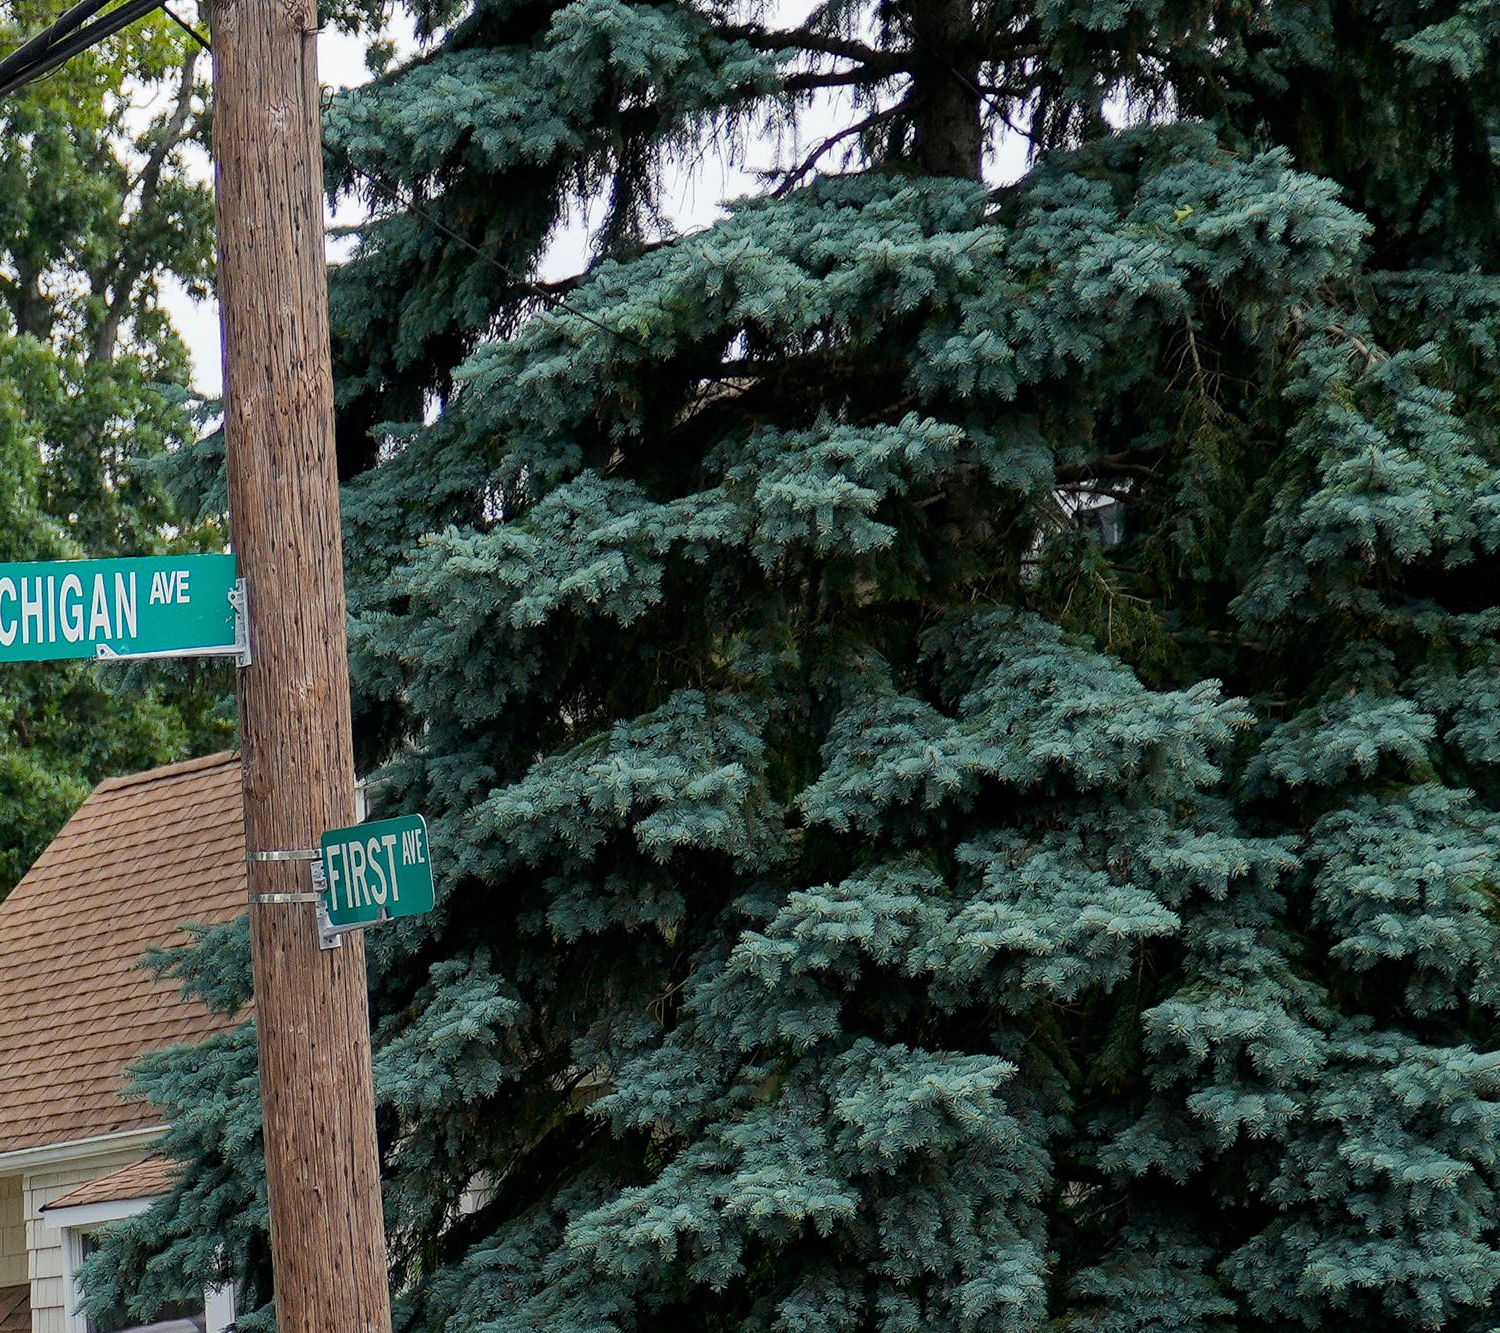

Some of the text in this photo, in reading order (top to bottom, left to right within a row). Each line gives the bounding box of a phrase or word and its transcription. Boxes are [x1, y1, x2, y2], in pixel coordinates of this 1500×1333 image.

[149, 570, 191, 604] AVE
[326, 832, 425, 911] FIRST AVE
